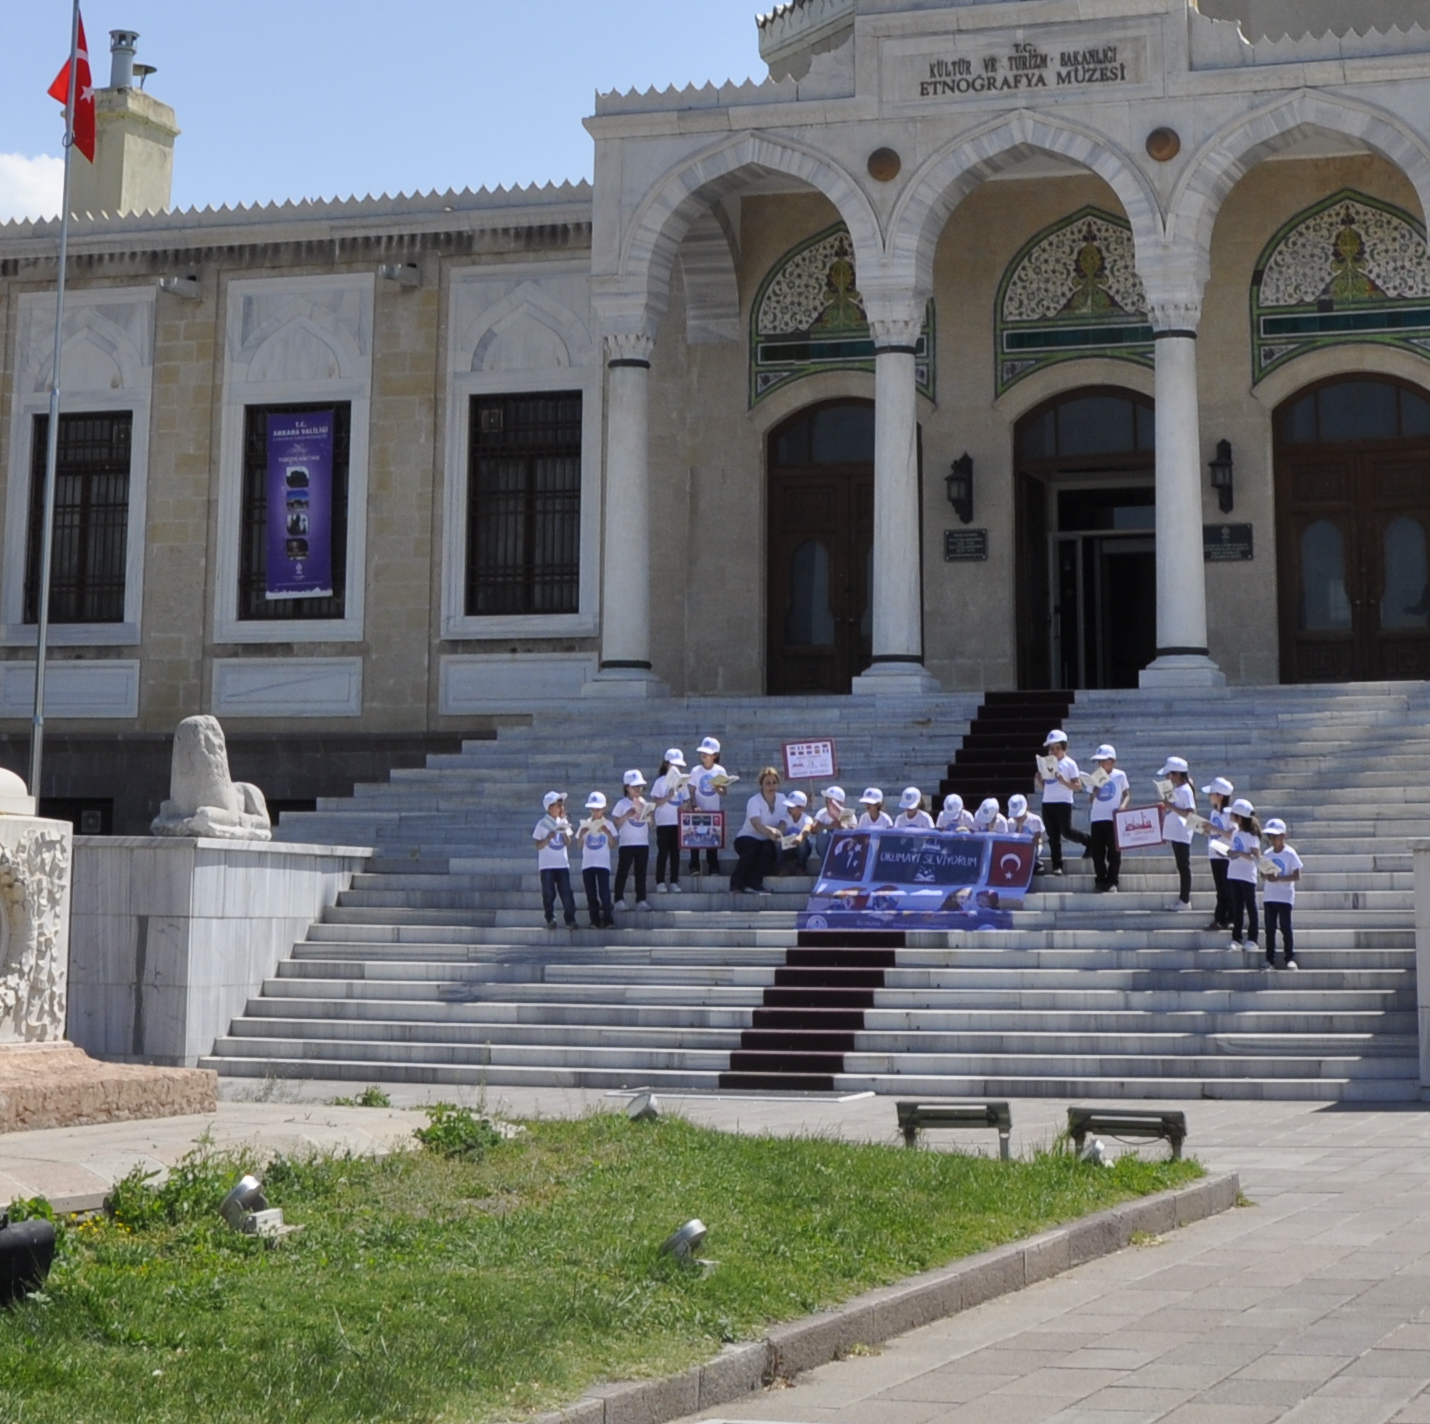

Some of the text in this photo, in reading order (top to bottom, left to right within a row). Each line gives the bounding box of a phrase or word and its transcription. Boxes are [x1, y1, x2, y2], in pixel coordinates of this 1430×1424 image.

[1012, 42, 1037, 54] T.C.
[929, 46, 1117, 79] KÜLTÜR VE TURİZM BAKANLIĞI
[1056, 62, 1126, 86] MÜZESİ
